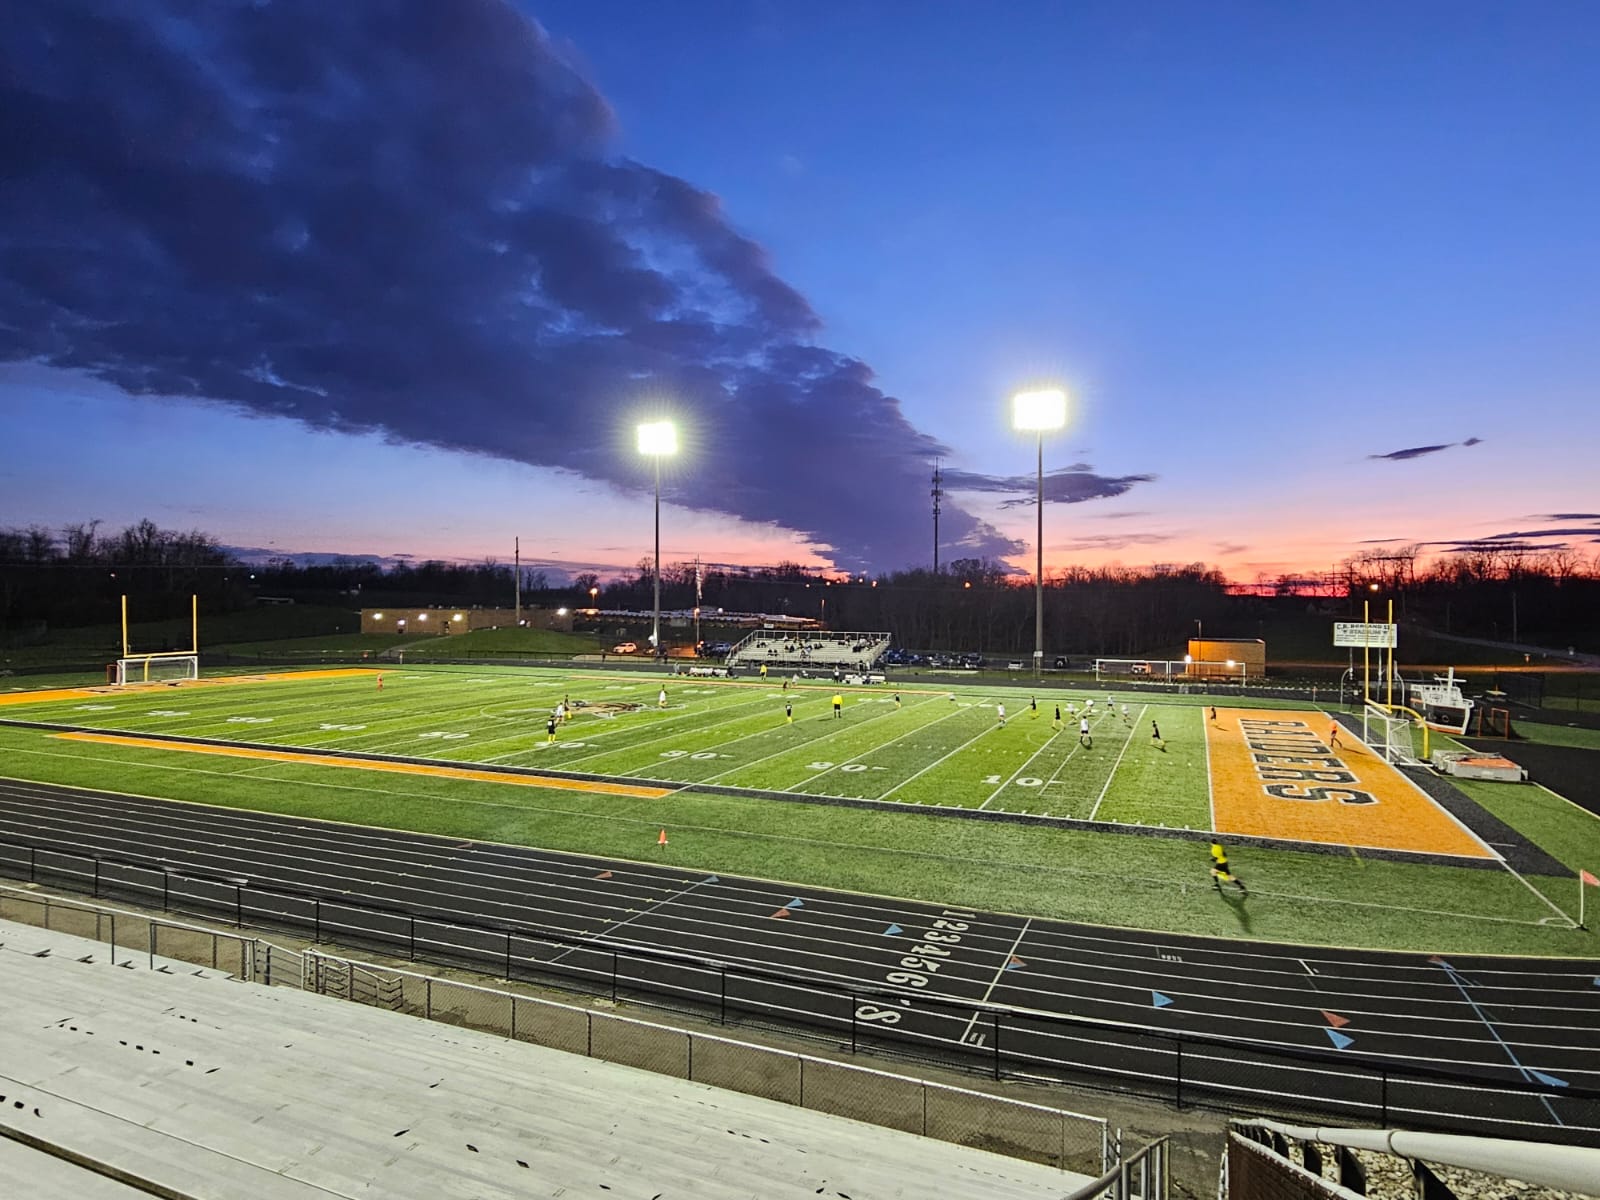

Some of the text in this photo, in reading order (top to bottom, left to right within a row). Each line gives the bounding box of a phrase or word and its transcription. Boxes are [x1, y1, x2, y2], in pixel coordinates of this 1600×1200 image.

[1238, 718, 1379, 805] RAIDERS
[981, 774, 1043, 787] 10
[942, 910, 977, 919] 1
[932, 919, 969, 932] 2
[923, 931, 962, 944] 3
[911, 944, 951, 957] 4
[900, 956, 941, 973] 5
[886, 971, 929, 988] 6
